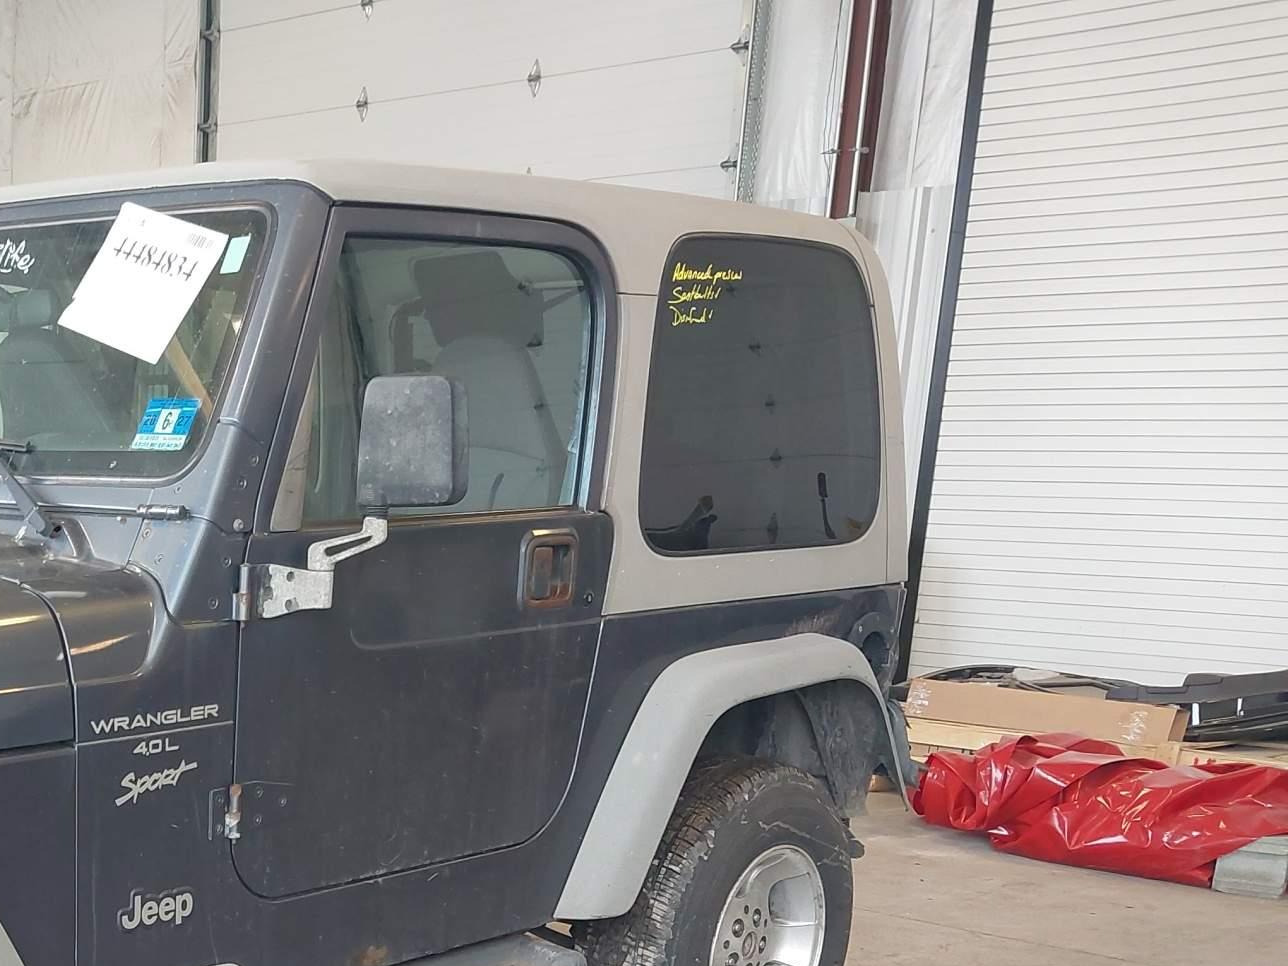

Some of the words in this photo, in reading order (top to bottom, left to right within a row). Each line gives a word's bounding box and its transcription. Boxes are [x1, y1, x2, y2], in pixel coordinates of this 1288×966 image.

[90, 704, 219, 734] WRANGLER
[114, 760, 198, 807] Sport
[121, 891, 193, 930] Jeep
